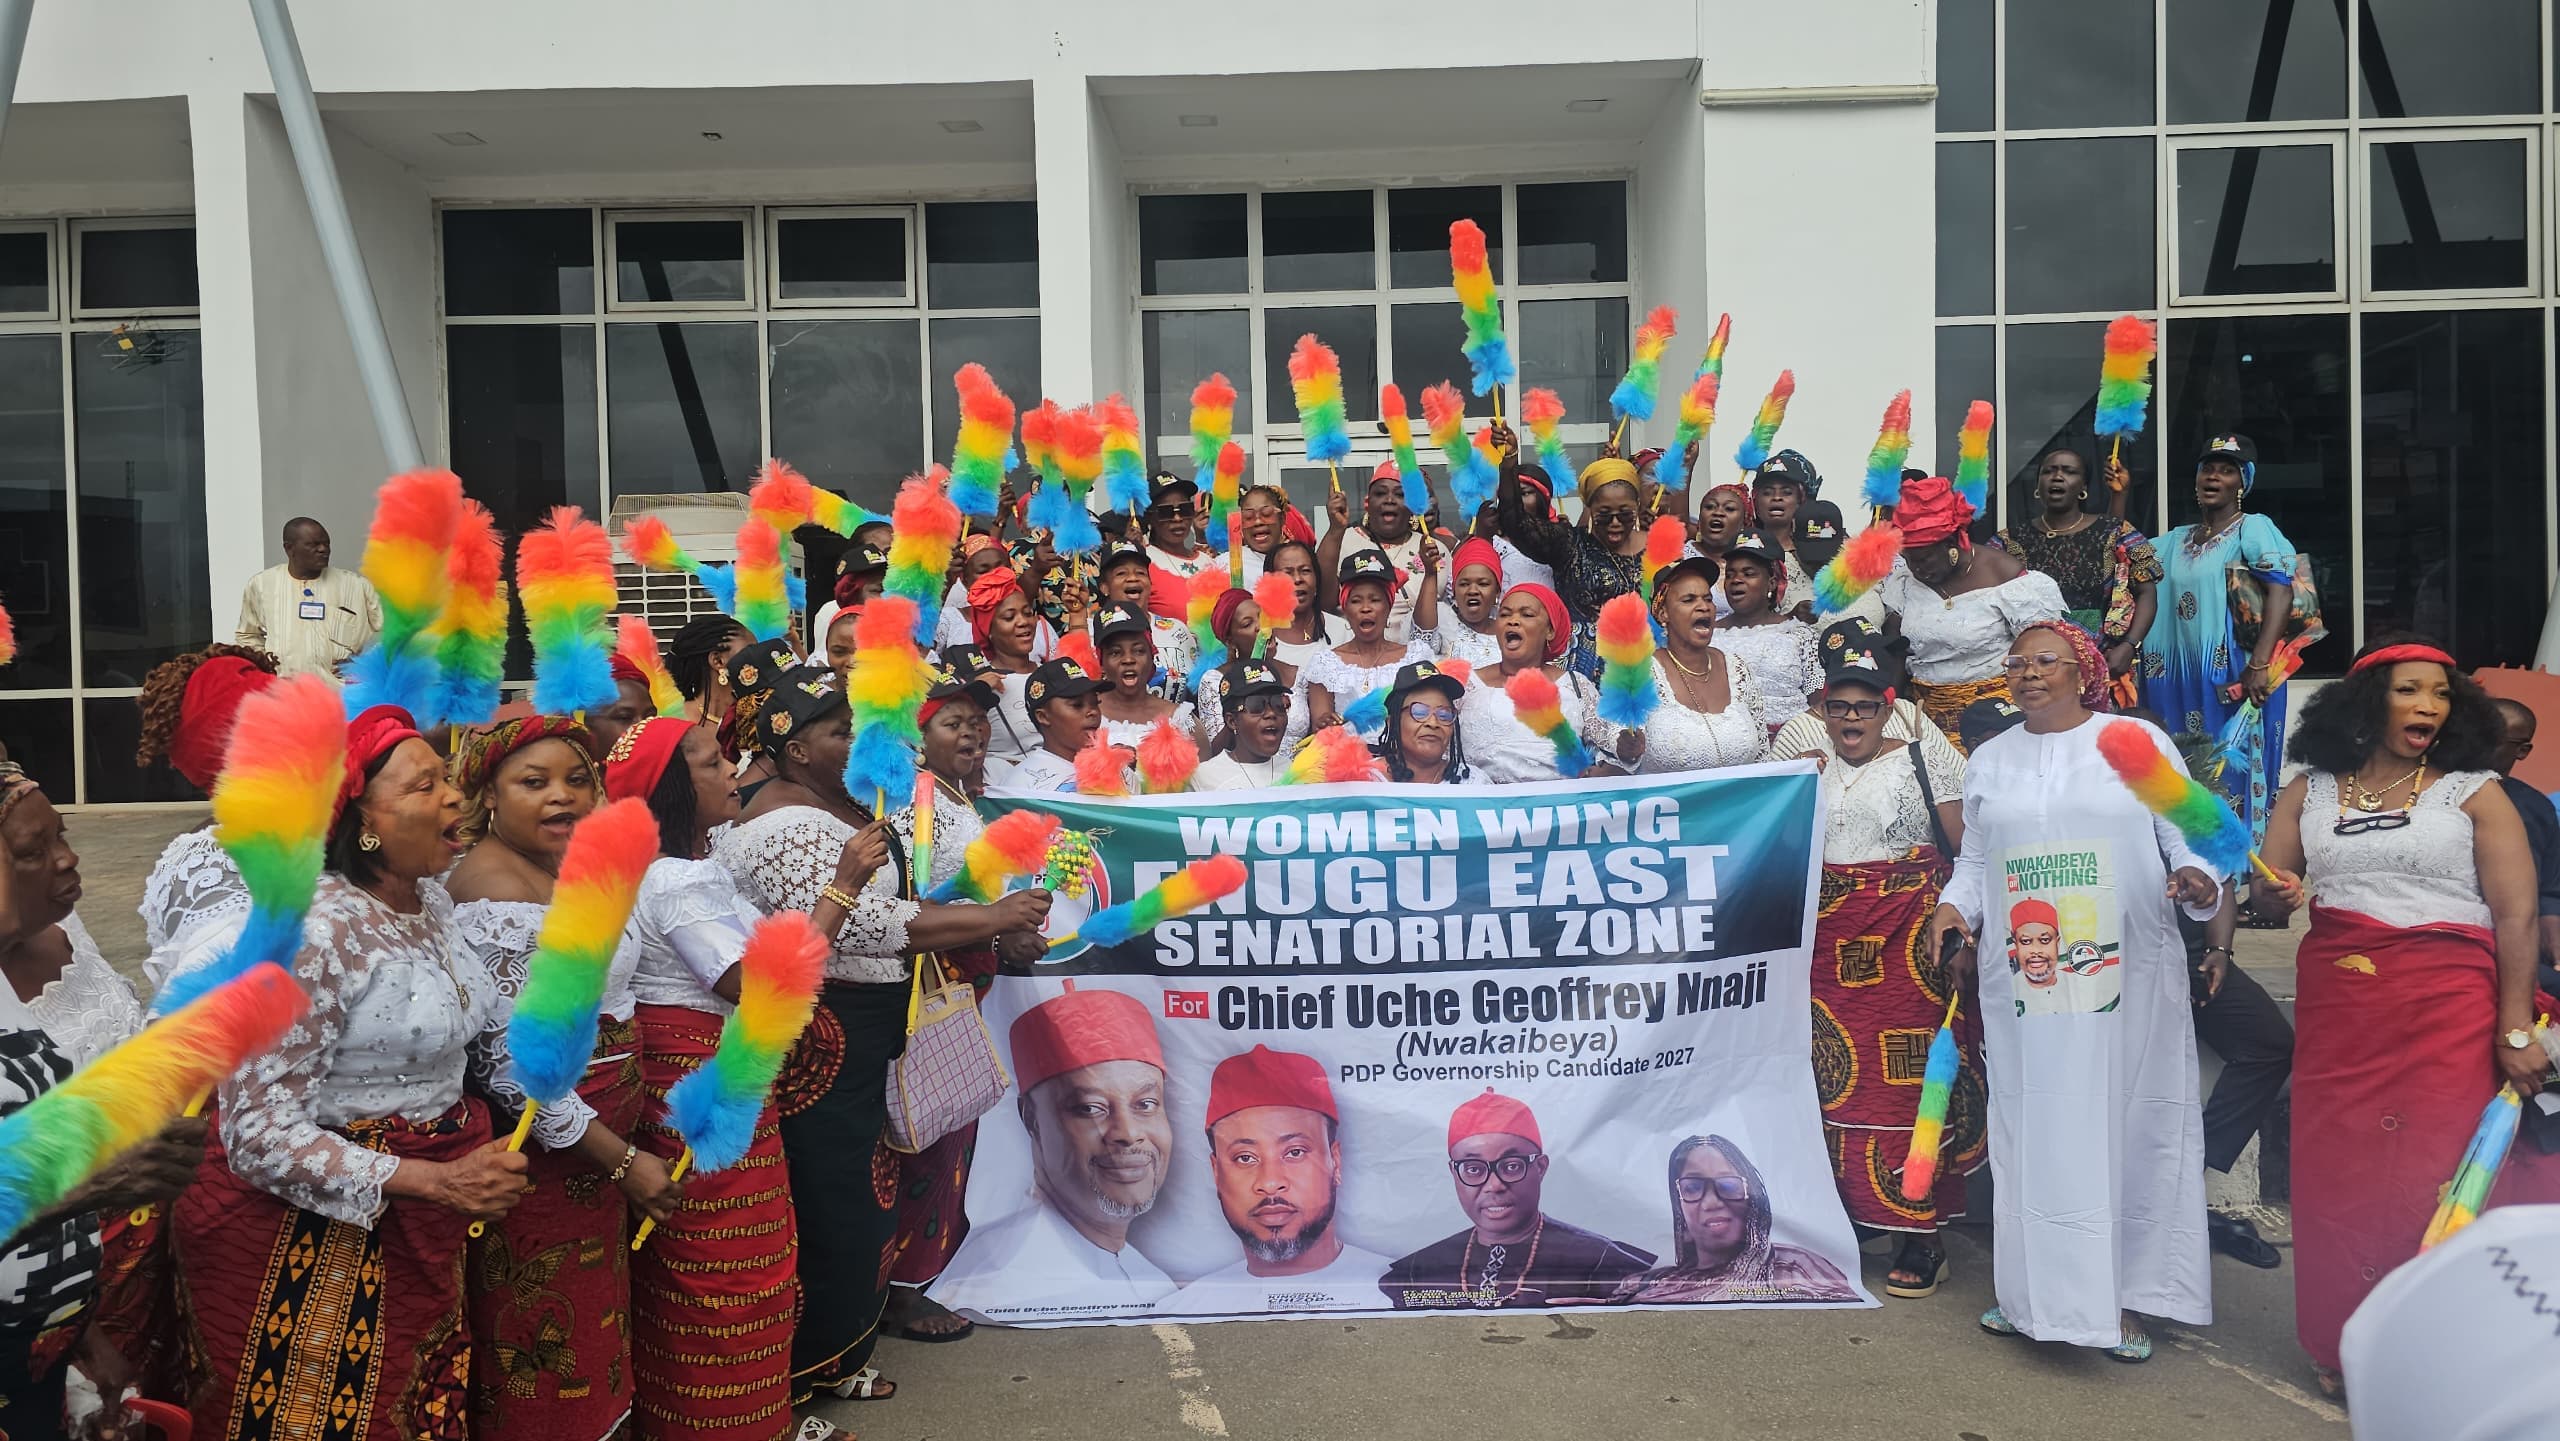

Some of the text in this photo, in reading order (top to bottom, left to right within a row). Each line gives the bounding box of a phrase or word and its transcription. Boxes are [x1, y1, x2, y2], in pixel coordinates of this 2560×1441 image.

[1179, 797, 1680, 855] WOMEN WING
[1489, 846, 1729, 907] EAST
[2006, 852, 2098, 875] NWAKAIBEYA
[2018, 867, 2098, 891] NOTHING
[1154, 905, 1715, 966] SENATORIAL ZONE
[1168, 994, 1204, 1015] For
[1217, 961, 1768, 1030] Chief Uche Geoffrey Nnaji
[1340, 1047, 1695, 1083] PDP Governorship Candidate 2027
[1396, 1025, 1618, 1066] (Nwakaibeya)
